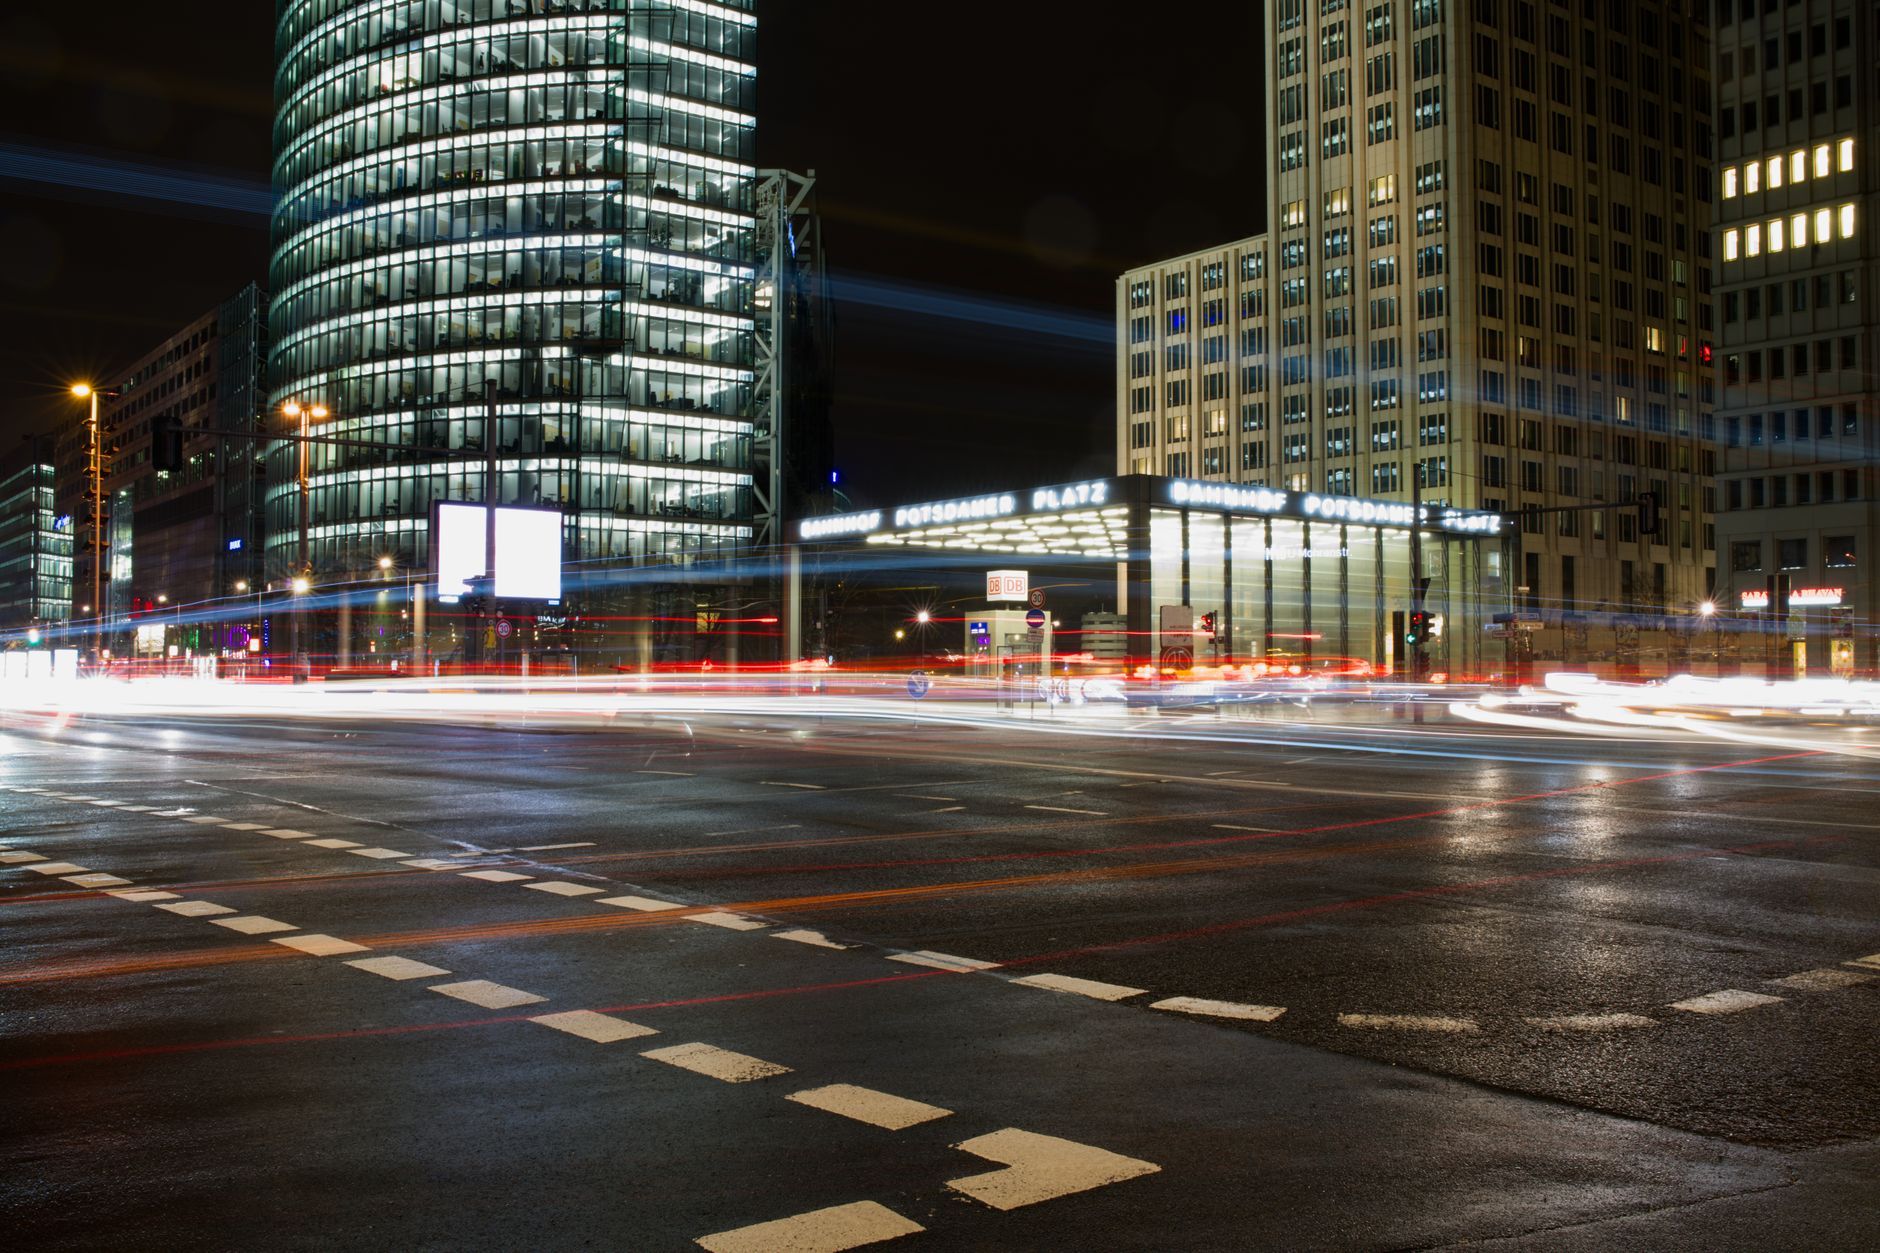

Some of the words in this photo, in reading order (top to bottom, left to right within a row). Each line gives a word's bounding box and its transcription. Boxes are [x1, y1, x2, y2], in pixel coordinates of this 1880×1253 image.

[1173, 482, 1286, 511] BAHNHOF
[801, 512, 880, 538] BAHNHOF
[896, 495, 1015, 526] POTSDAMER
[1033, 482, 1106, 509] PLATZ
[989, 579, 1000, 592] DB
[1007, 579, 1023, 592] DB
[1033, 593, 1041, 603] 30
[500, 624, 509, 634] 30
